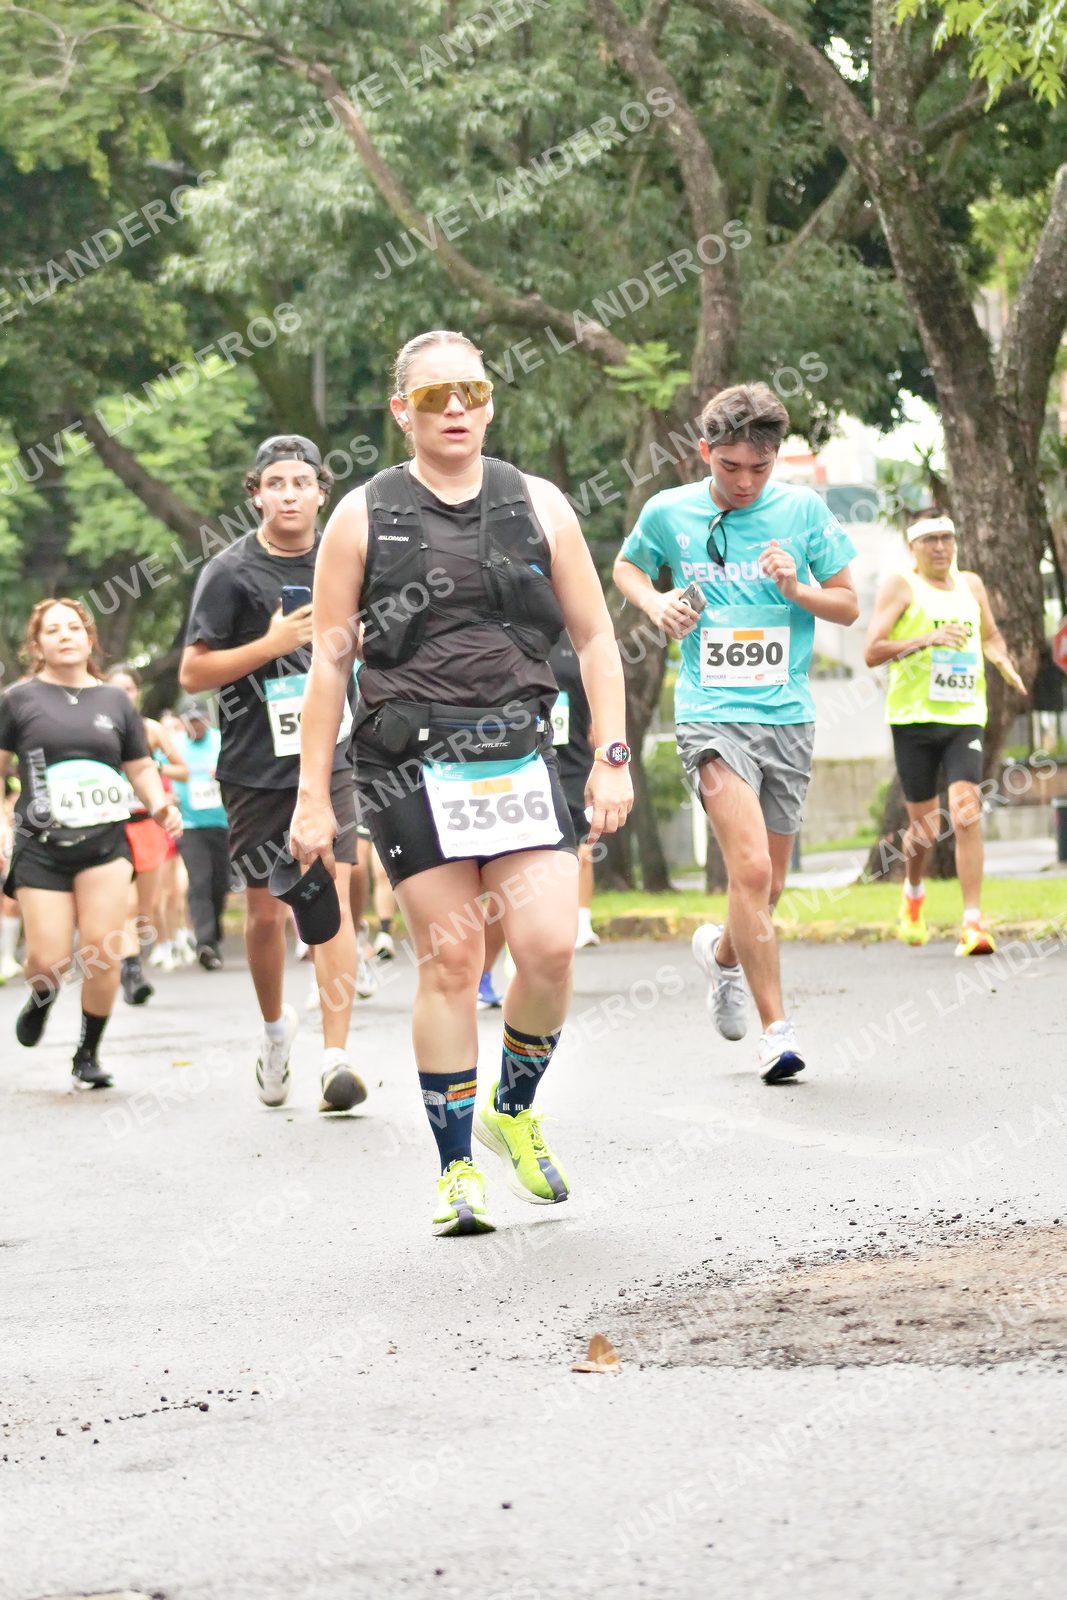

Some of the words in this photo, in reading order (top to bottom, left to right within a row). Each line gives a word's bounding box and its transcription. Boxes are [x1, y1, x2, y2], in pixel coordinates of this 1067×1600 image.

[706, 642, 783, 667] 3690
[934, 673, 975, 689] 4633
[60, 786, 122, 810] 4100
[441, 790, 550, 831] 3366
